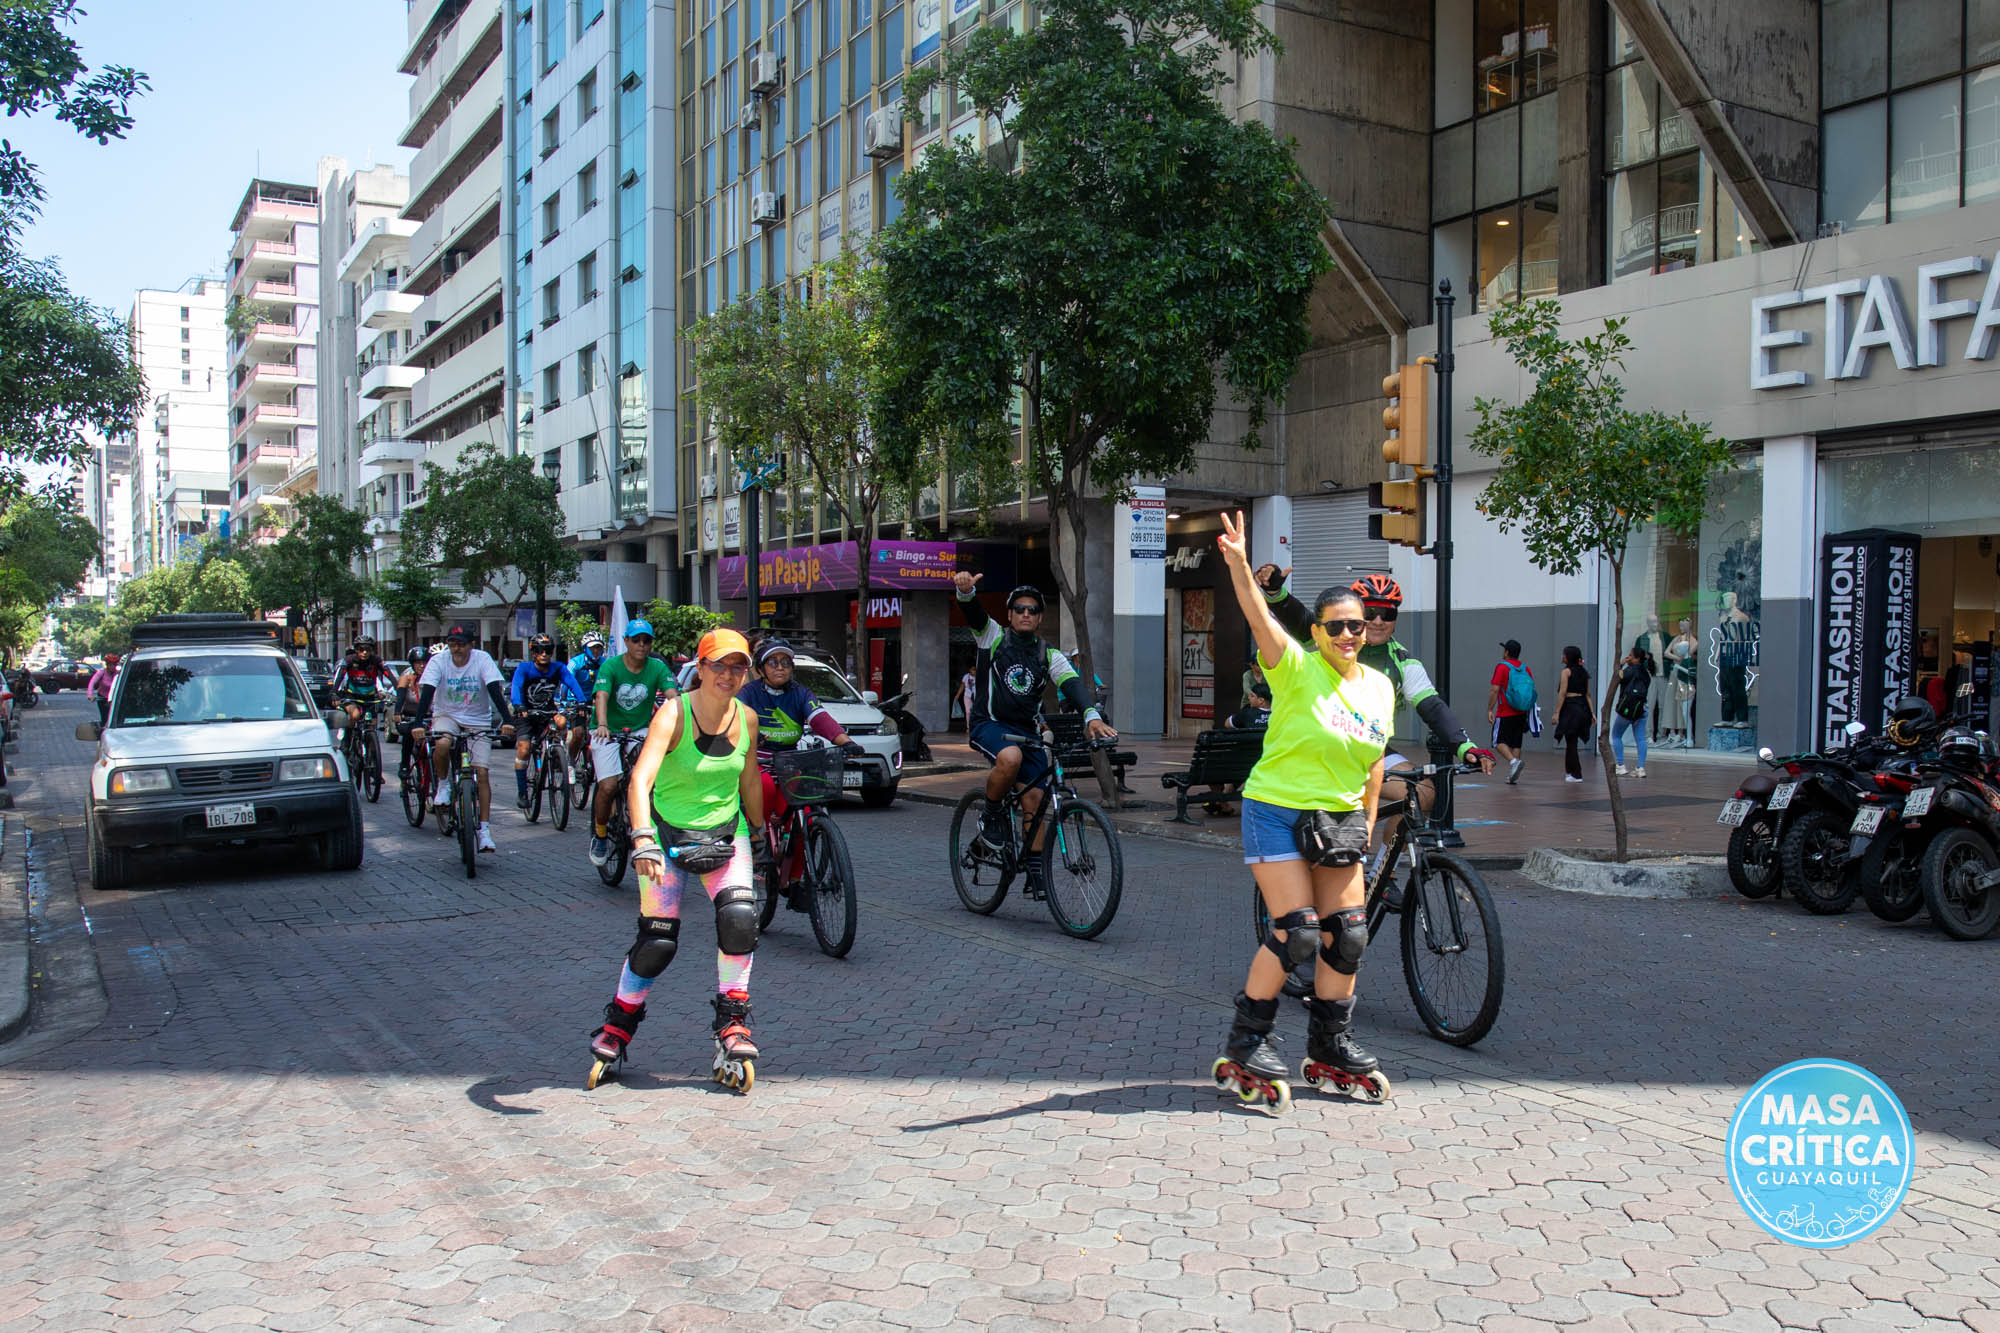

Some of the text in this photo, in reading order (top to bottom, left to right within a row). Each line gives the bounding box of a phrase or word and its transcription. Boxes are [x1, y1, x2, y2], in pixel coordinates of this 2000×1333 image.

[820, 190, 870, 229] NOTAIA 21
[775, 549, 820, 591] Pasaje
[895, 550, 925, 563] Bingo
[900, 567, 957, 580] Gran Pasaje
[1857, 546, 1865, 585] PUEDO
[1904, 547, 1913, 585] PUEDO
[1854, 600, 1864, 651] QUIERO
[1902, 602, 1912, 651] QUIERO
[1825, 546, 1855, 749] ETAFASHION
[1854, 654, 1861, 672] LO
[1851, 676, 1860, 722] NCANTA
[208, 811, 255, 827] IBL-708
[1728, 803, 1742, 814] KB
[1862, 811, 1876, 823] JN
